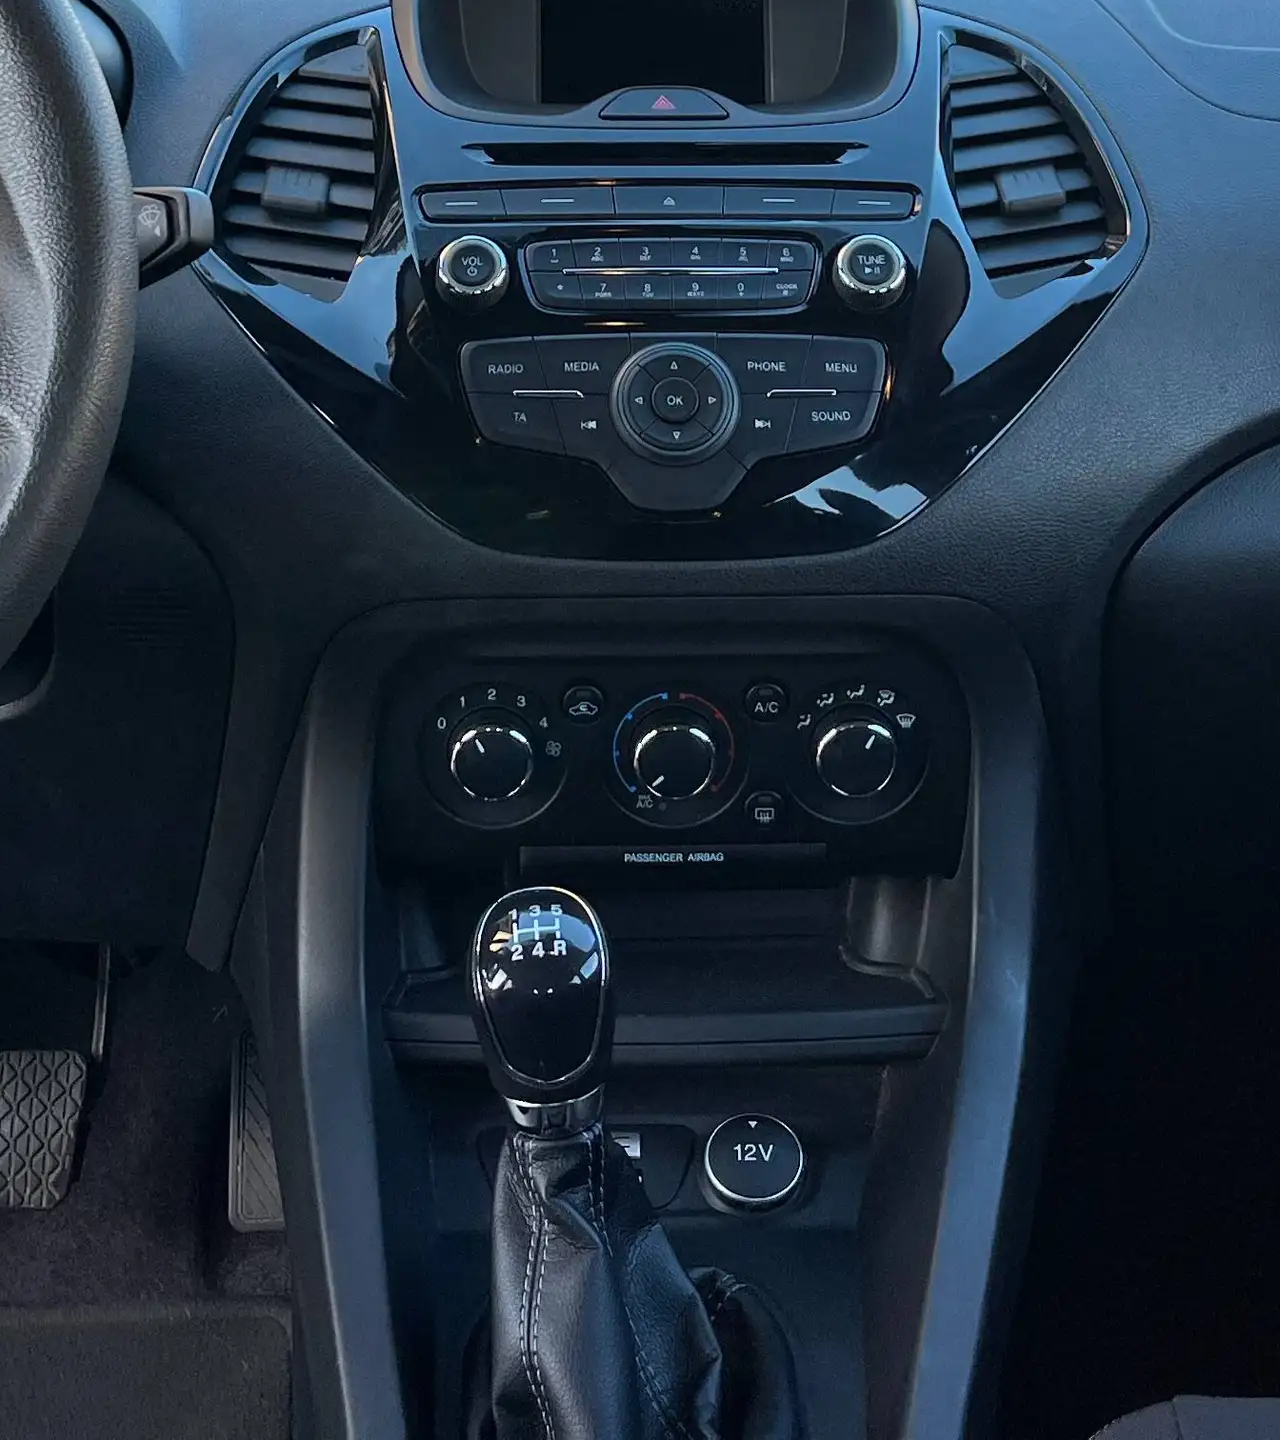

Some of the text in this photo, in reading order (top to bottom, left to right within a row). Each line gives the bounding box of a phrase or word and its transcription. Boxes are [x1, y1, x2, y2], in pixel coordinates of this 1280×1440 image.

[594, 246, 601, 256] 2
[641, 246, 649, 256] 3
[691, 246, 699, 255] 4
[739, 246, 747, 256] 5
[461, 256, 484, 266] VOL
[857, 254, 886, 265] TUNE
[600, 283, 607, 292] 7
[644, 283, 651, 293] 8
[692, 282, 699, 292] 9
[737, 282, 745, 292] 0
[488, 364, 524, 374] RADIO
[564, 361, 600, 372] MEDIA
[747, 361, 786, 372] PHONE
[825, 362, 858, 373] MENU
[666, 395, 684, 406] OK
[513, 412, 527, 423] TA
[811, 410, 851, 422] SOUND
[437, 716, 447, 729] 0
[487, 688, 497, 700] 2
[516, 695, 527, 707] 3
[539, 716, 549, 728] 4
[754, 701, 780, 713] A/C
[636, 799, 654, 808] A/C
[624, 852, 724, 863] PASSENGER AIRBAG
[508, 904, 563, 920] 1 3 5
[511, 939, 567, 961] 2 4 R
[733, 1143, 774, 1162] 12V
